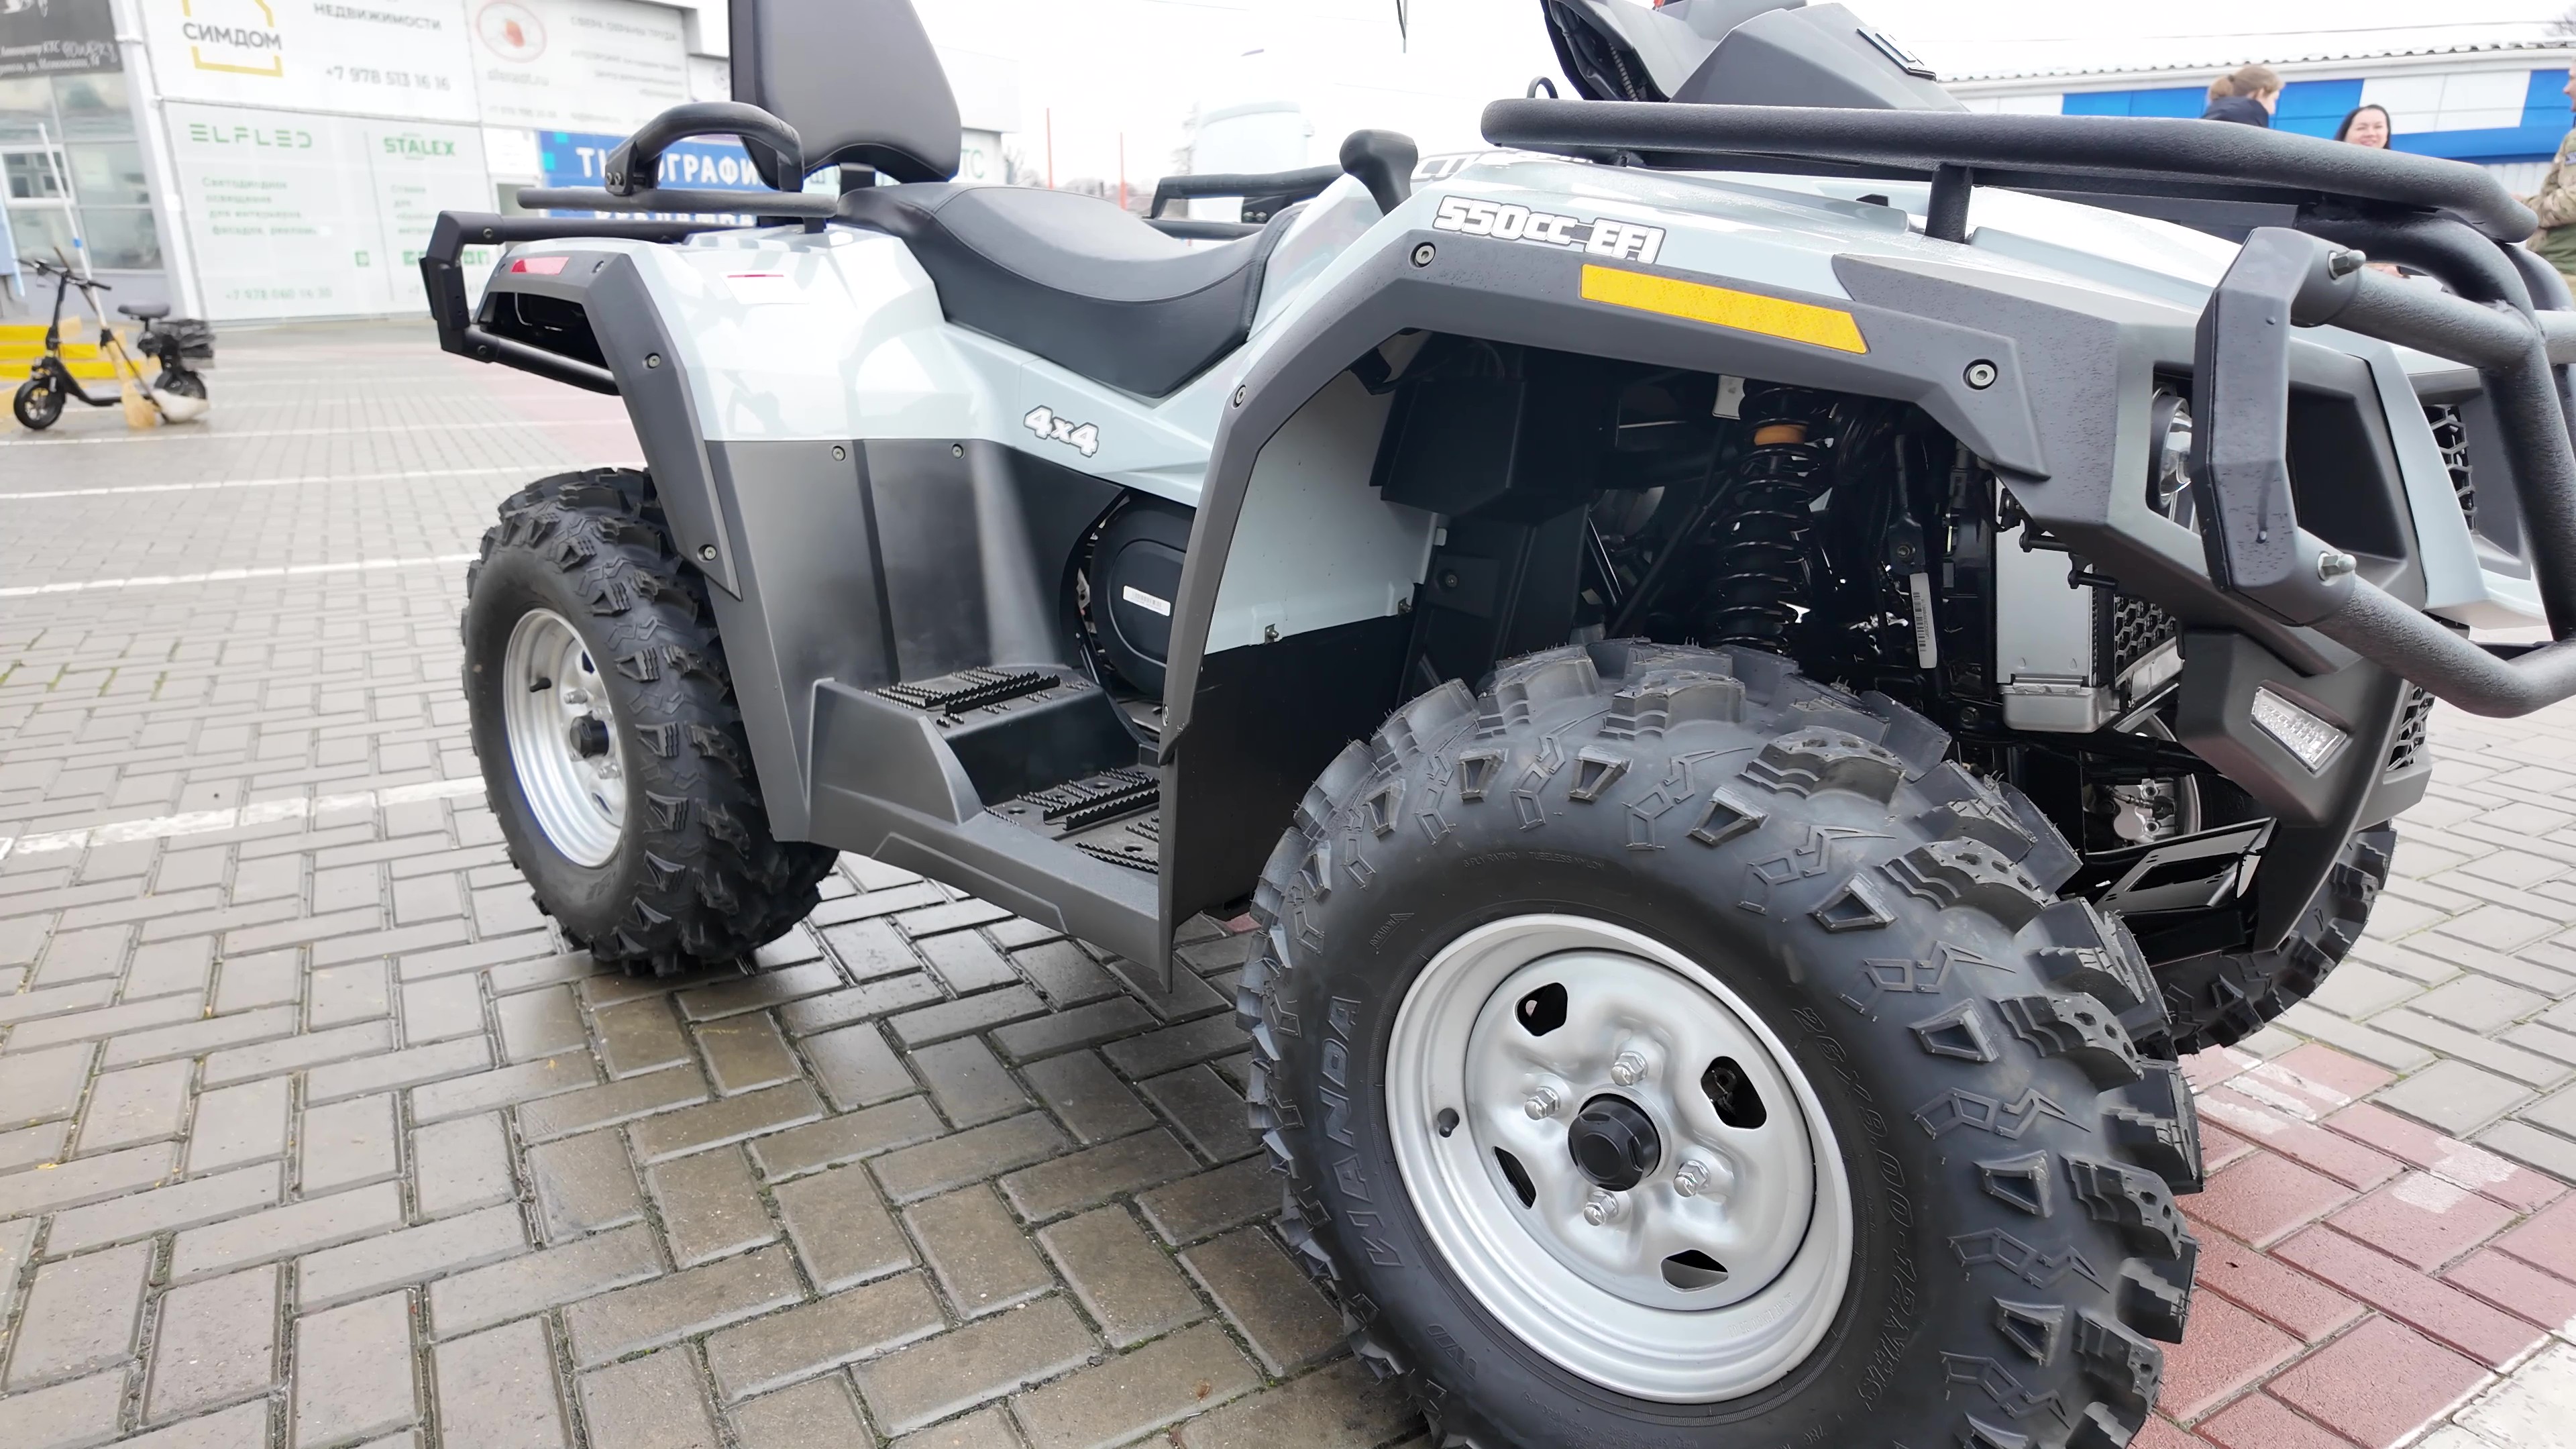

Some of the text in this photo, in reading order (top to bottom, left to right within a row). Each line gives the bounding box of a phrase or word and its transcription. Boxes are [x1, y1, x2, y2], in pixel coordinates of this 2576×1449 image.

[313, 3, 442, 31] НЕДВИЖИМОСТИ
[182, 22, 282, 50] СИМДОМ
[350, 67, 382, 85] 978
[189, 123, 313, 149] ELFLED
[384, 137, 456, 157] STALEX
[1024, 405, 1099, 458] 4x4
[1487, 851, 1517, 863] RATING
[1528, 851, 1572, 863] TUBELESS
[1574, 856, 1605, 870] NYLON
[1319, 996, 1403, 1267] WANDA
